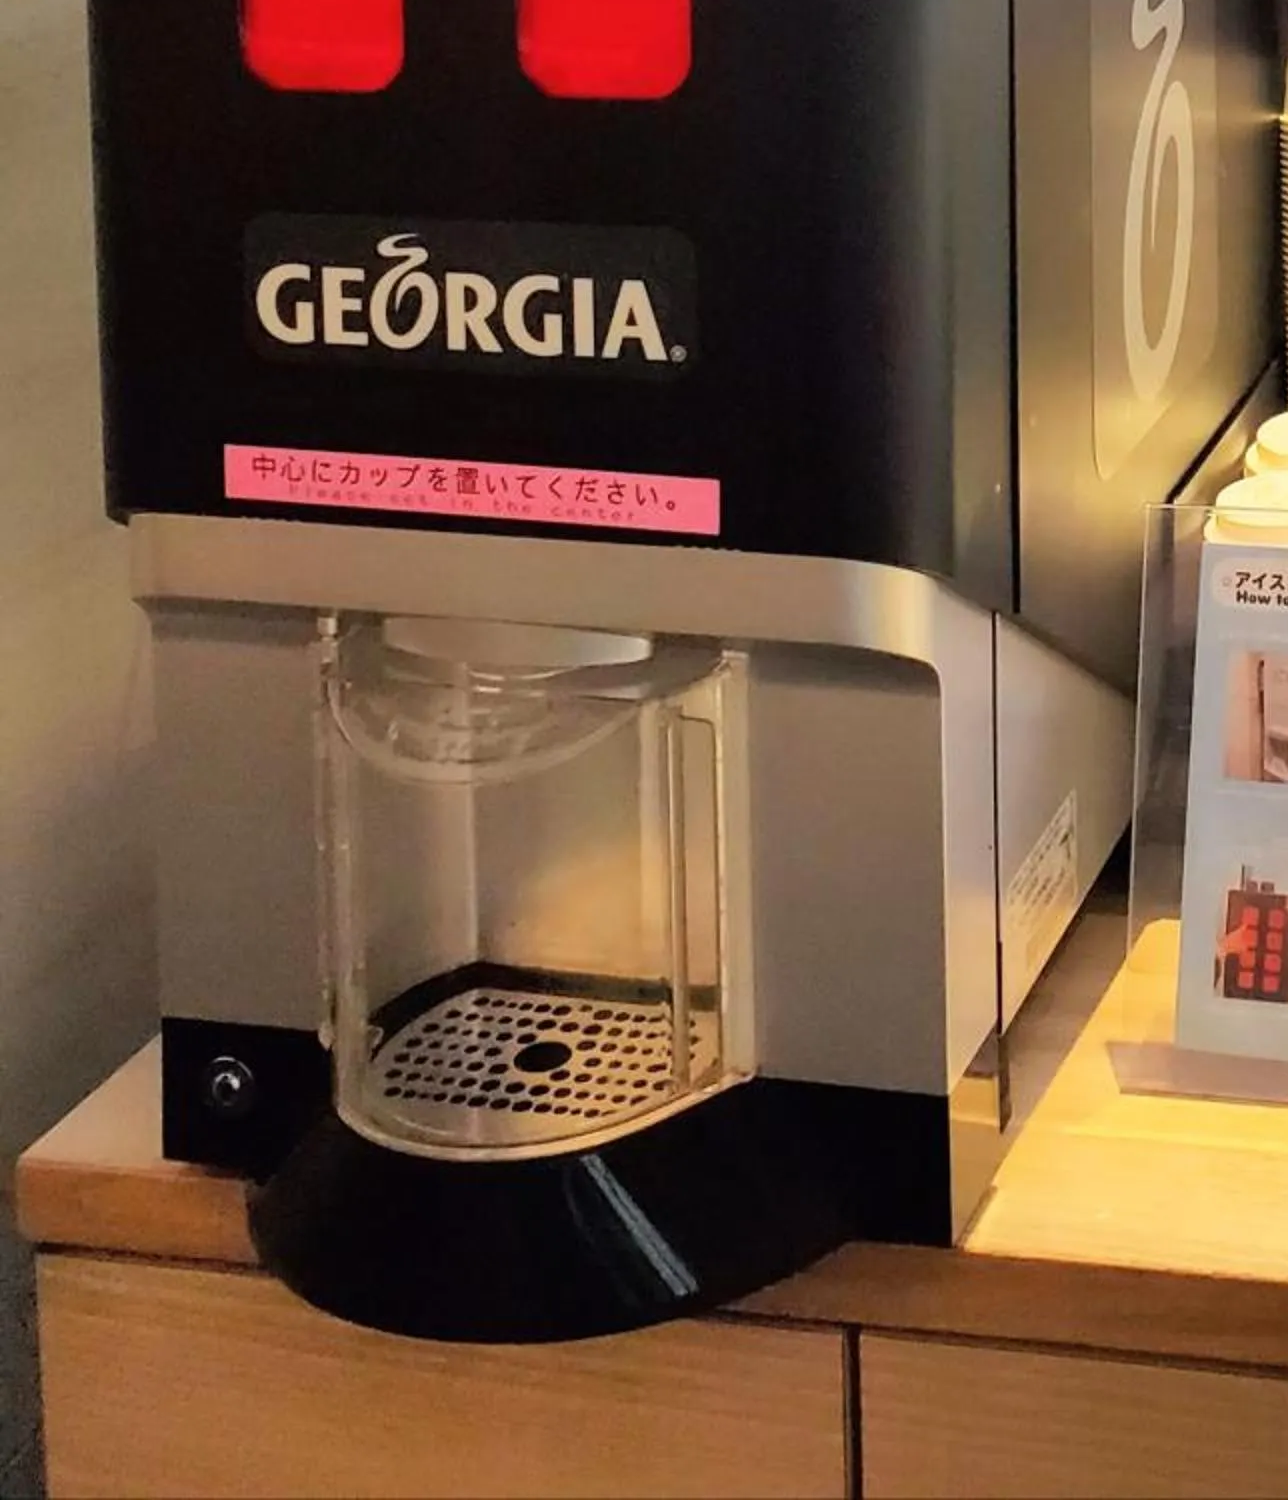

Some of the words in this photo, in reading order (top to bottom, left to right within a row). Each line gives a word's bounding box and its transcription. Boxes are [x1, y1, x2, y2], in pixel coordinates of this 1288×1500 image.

[255, 233, 669, 362] GEORGIA
[252, 452, 676, 512] 中心にカップを置いてください。
[1236, 590, 1271, 605] How
